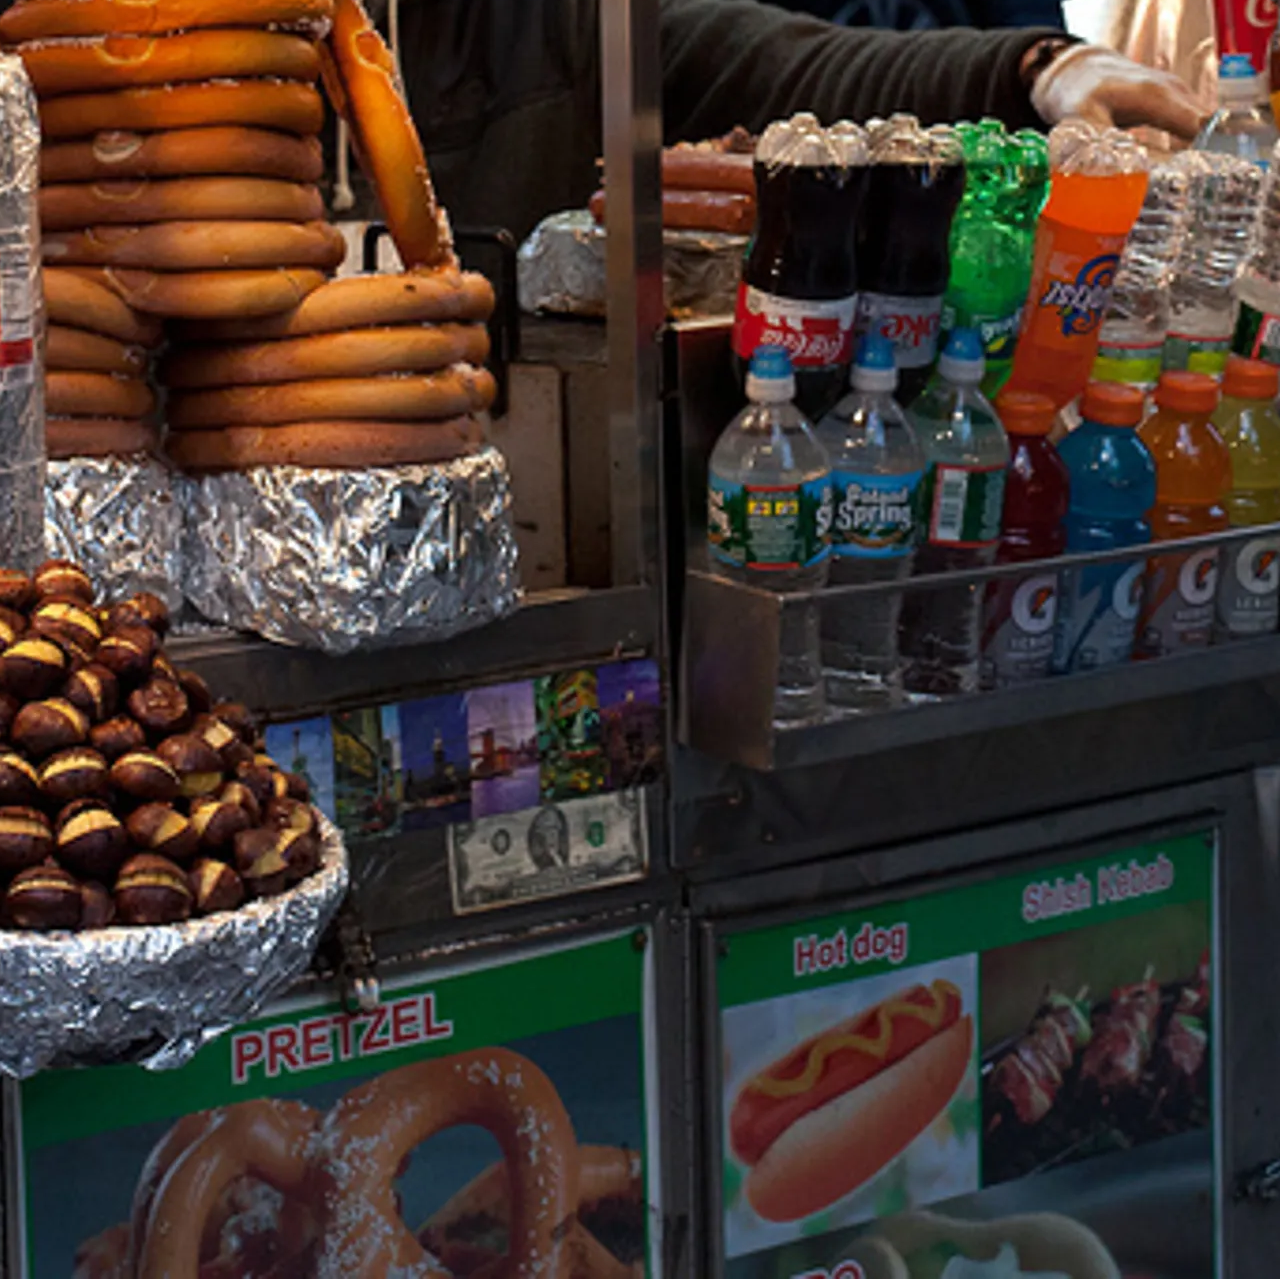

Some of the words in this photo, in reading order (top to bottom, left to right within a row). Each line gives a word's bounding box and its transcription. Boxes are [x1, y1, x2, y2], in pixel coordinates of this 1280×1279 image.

[835, 504, 912, 531] Spring
[845, 483, 909, 505] Poland
[1021, 871, 1093, 924] Shish
[1096, 852, 1175, 906] Kebab
[793, 925, 849, 977] Hot
[851, 921, 910, 967] dog
[231, 992, 454, 1085] PRETZEL
